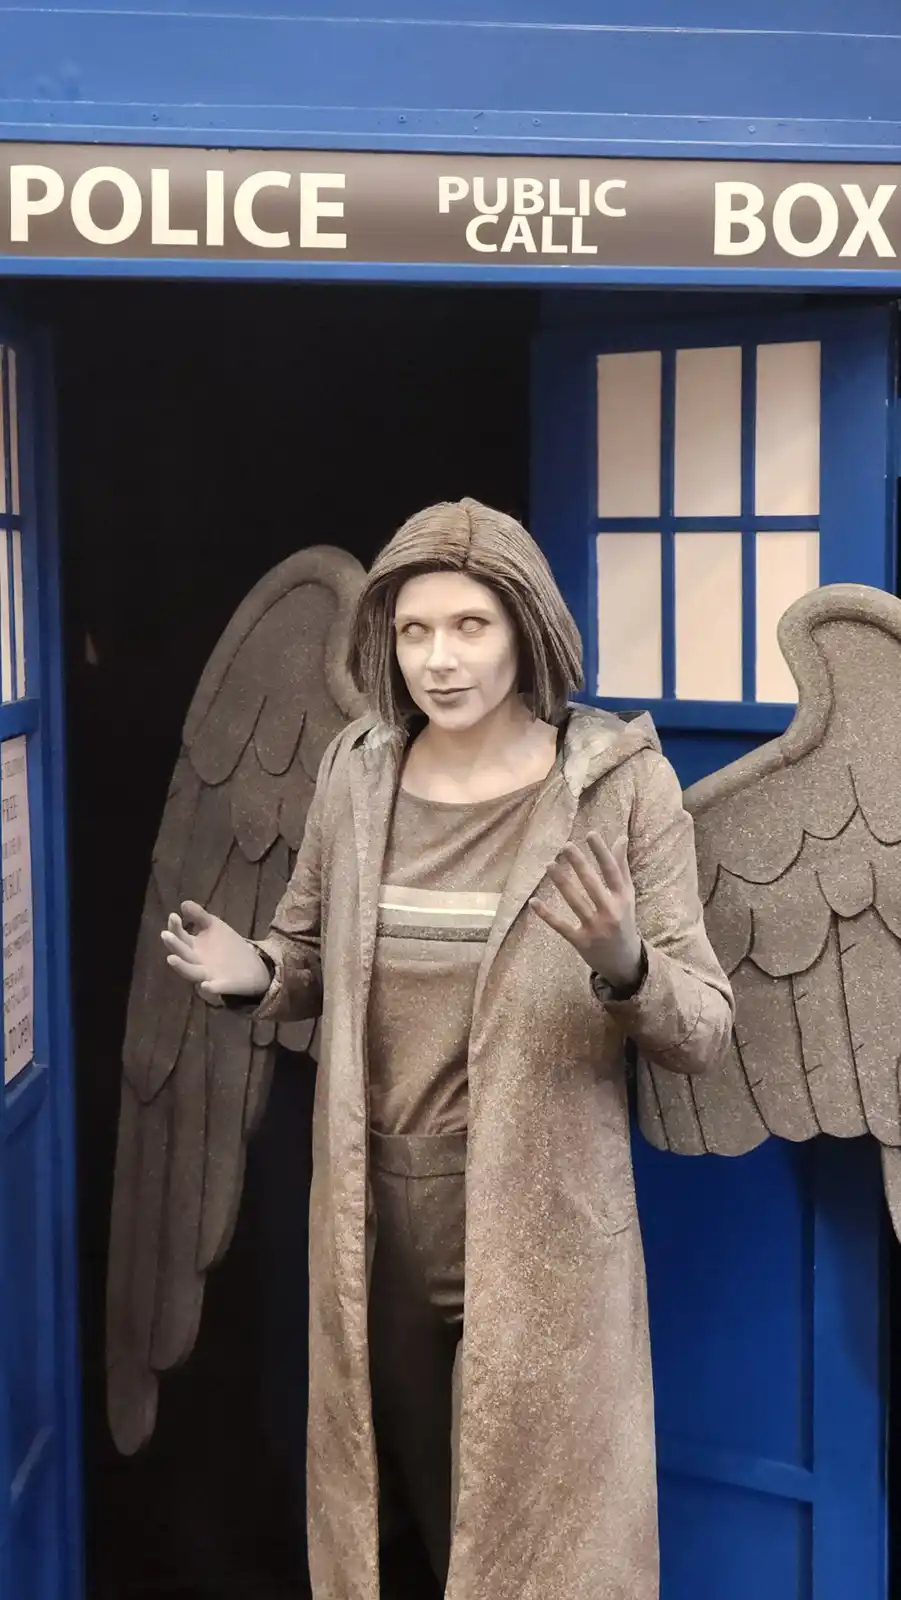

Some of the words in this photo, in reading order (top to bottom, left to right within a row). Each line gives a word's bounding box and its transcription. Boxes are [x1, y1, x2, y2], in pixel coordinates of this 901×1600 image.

[10, 165, 347, 249] POLICE
[438, 176, 627, 218] PUBLIC
[713, 181, 898, 258] BOX
[465, 214, 598, 254] CALL
